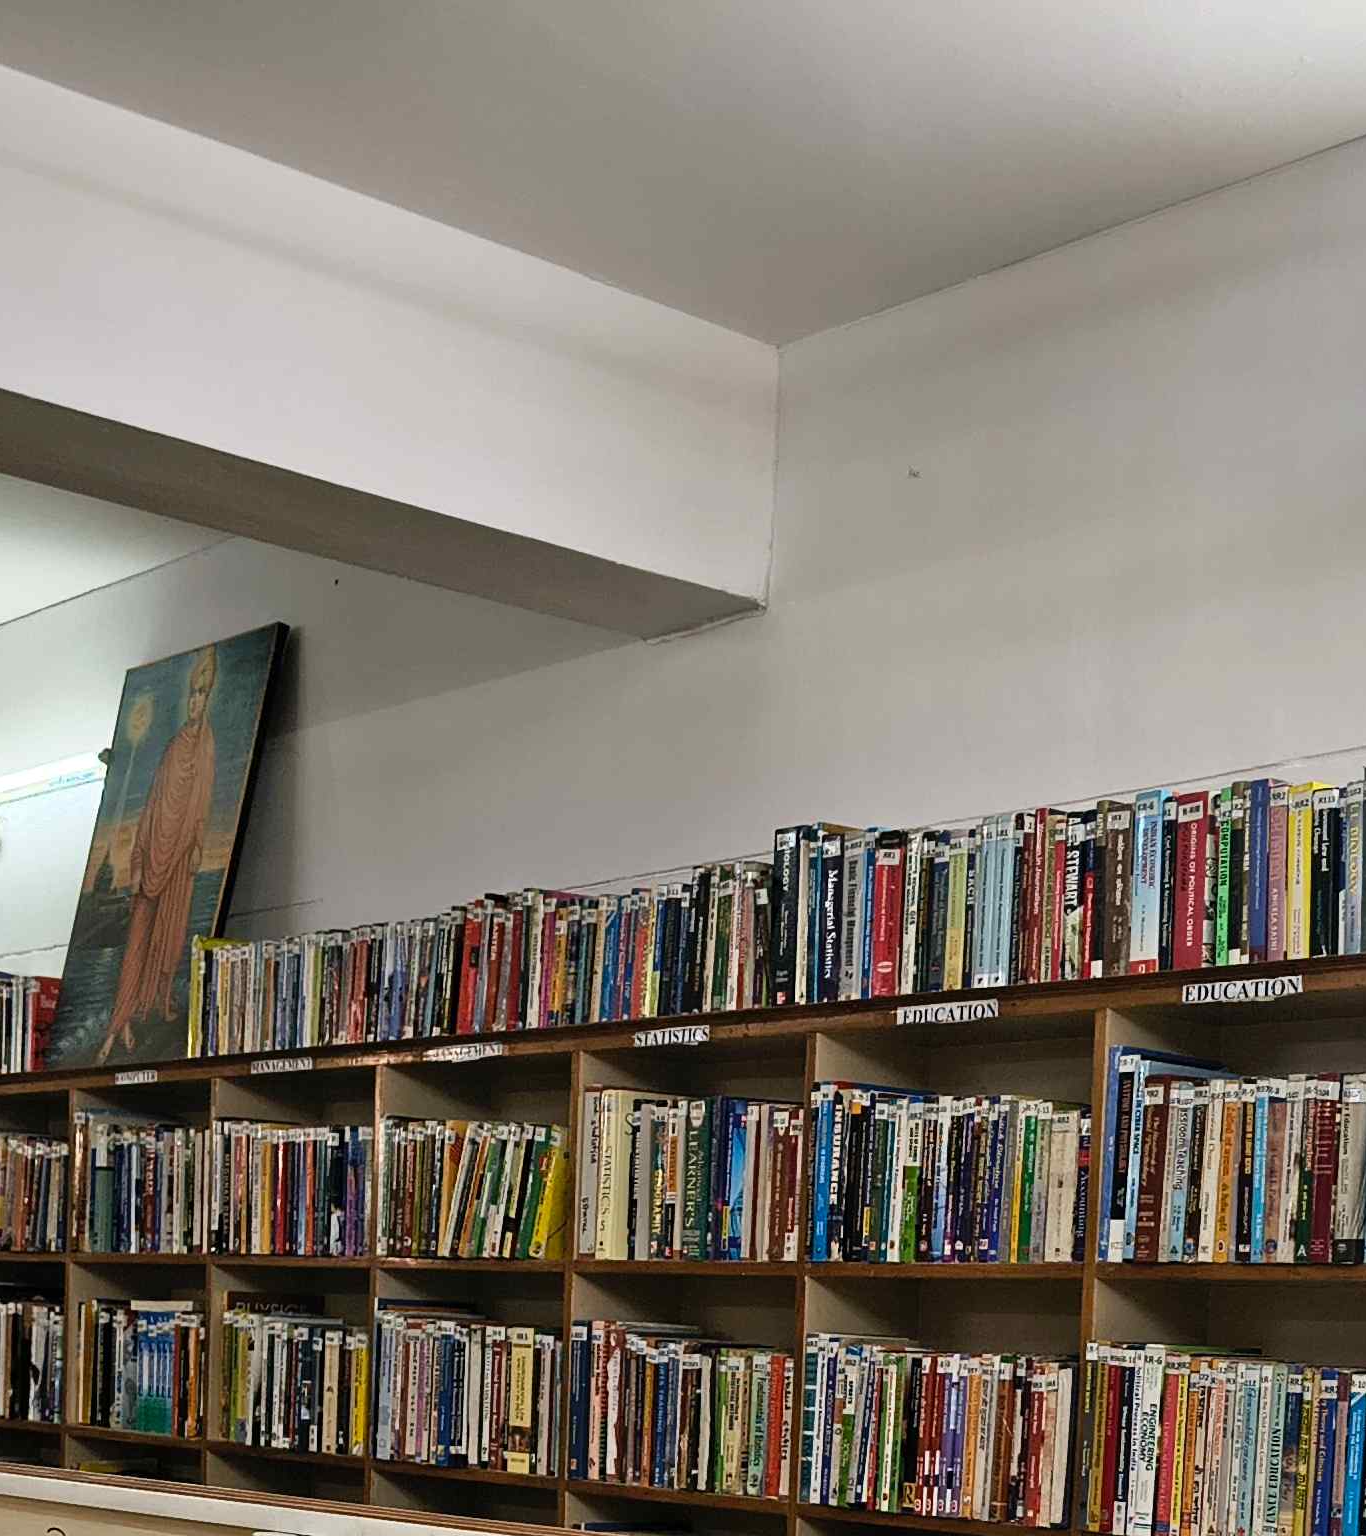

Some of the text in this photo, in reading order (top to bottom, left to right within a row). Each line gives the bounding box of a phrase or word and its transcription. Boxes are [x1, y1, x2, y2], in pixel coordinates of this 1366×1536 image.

[1065, 850, 1080, 906] STEWART
[1186, 875, 1196, 917] POLITICAL
[824, 869, 839, 978] Managerial Statistics
[902, 1001, 996, 1025] EDUCATION
[1184, 977, 1300, 1002] EDUCATION
[635, 1026, 709, 1047] STATISTICS
[684, 1130, 700, 1227] LEARNER'S
[1138, 1412, 1149, 1462] ECONOMY
[1146, 1403, 1157, 1471] ENGINEERING
